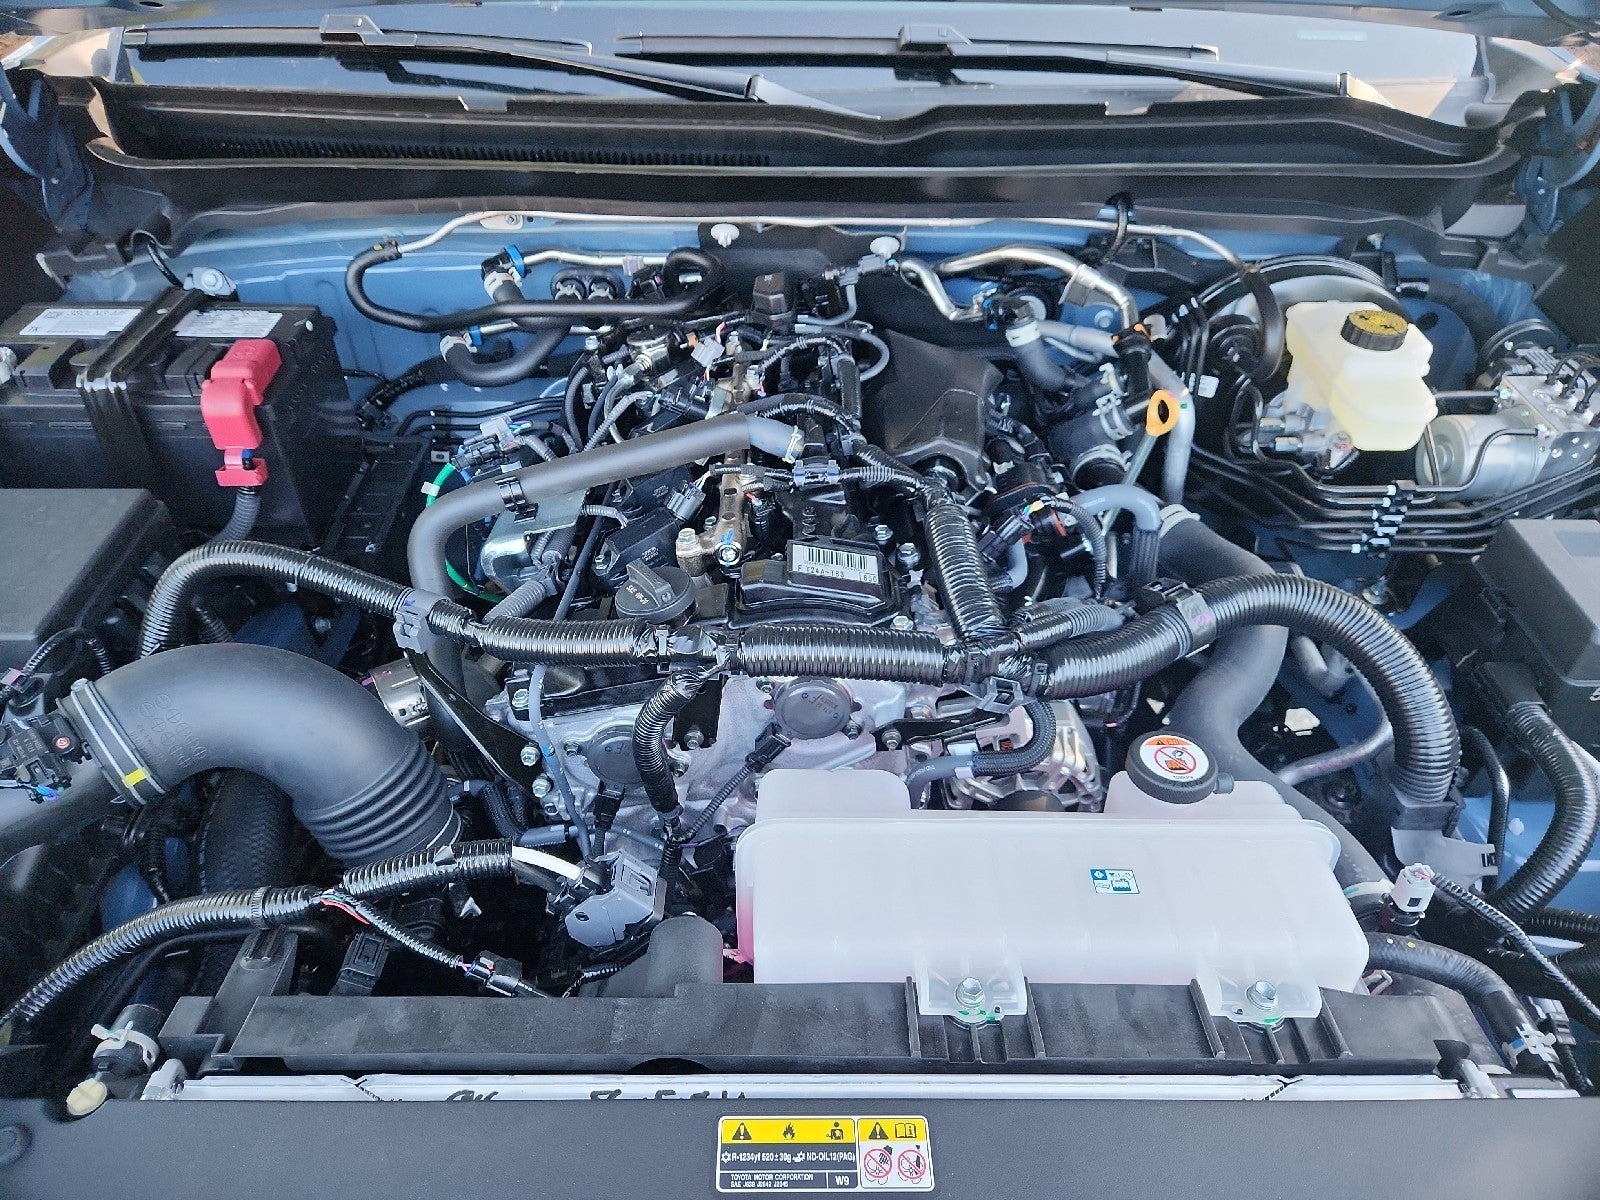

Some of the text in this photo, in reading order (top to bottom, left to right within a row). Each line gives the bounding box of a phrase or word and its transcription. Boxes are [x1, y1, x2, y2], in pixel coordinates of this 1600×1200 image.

[806, 1151, 856, 1163] ND-OIL12(PAG)
[730, 1173, 814, 1181] TOYOTA MOTOR CORPORATION
[835, 1175, 850, 1186] W9
